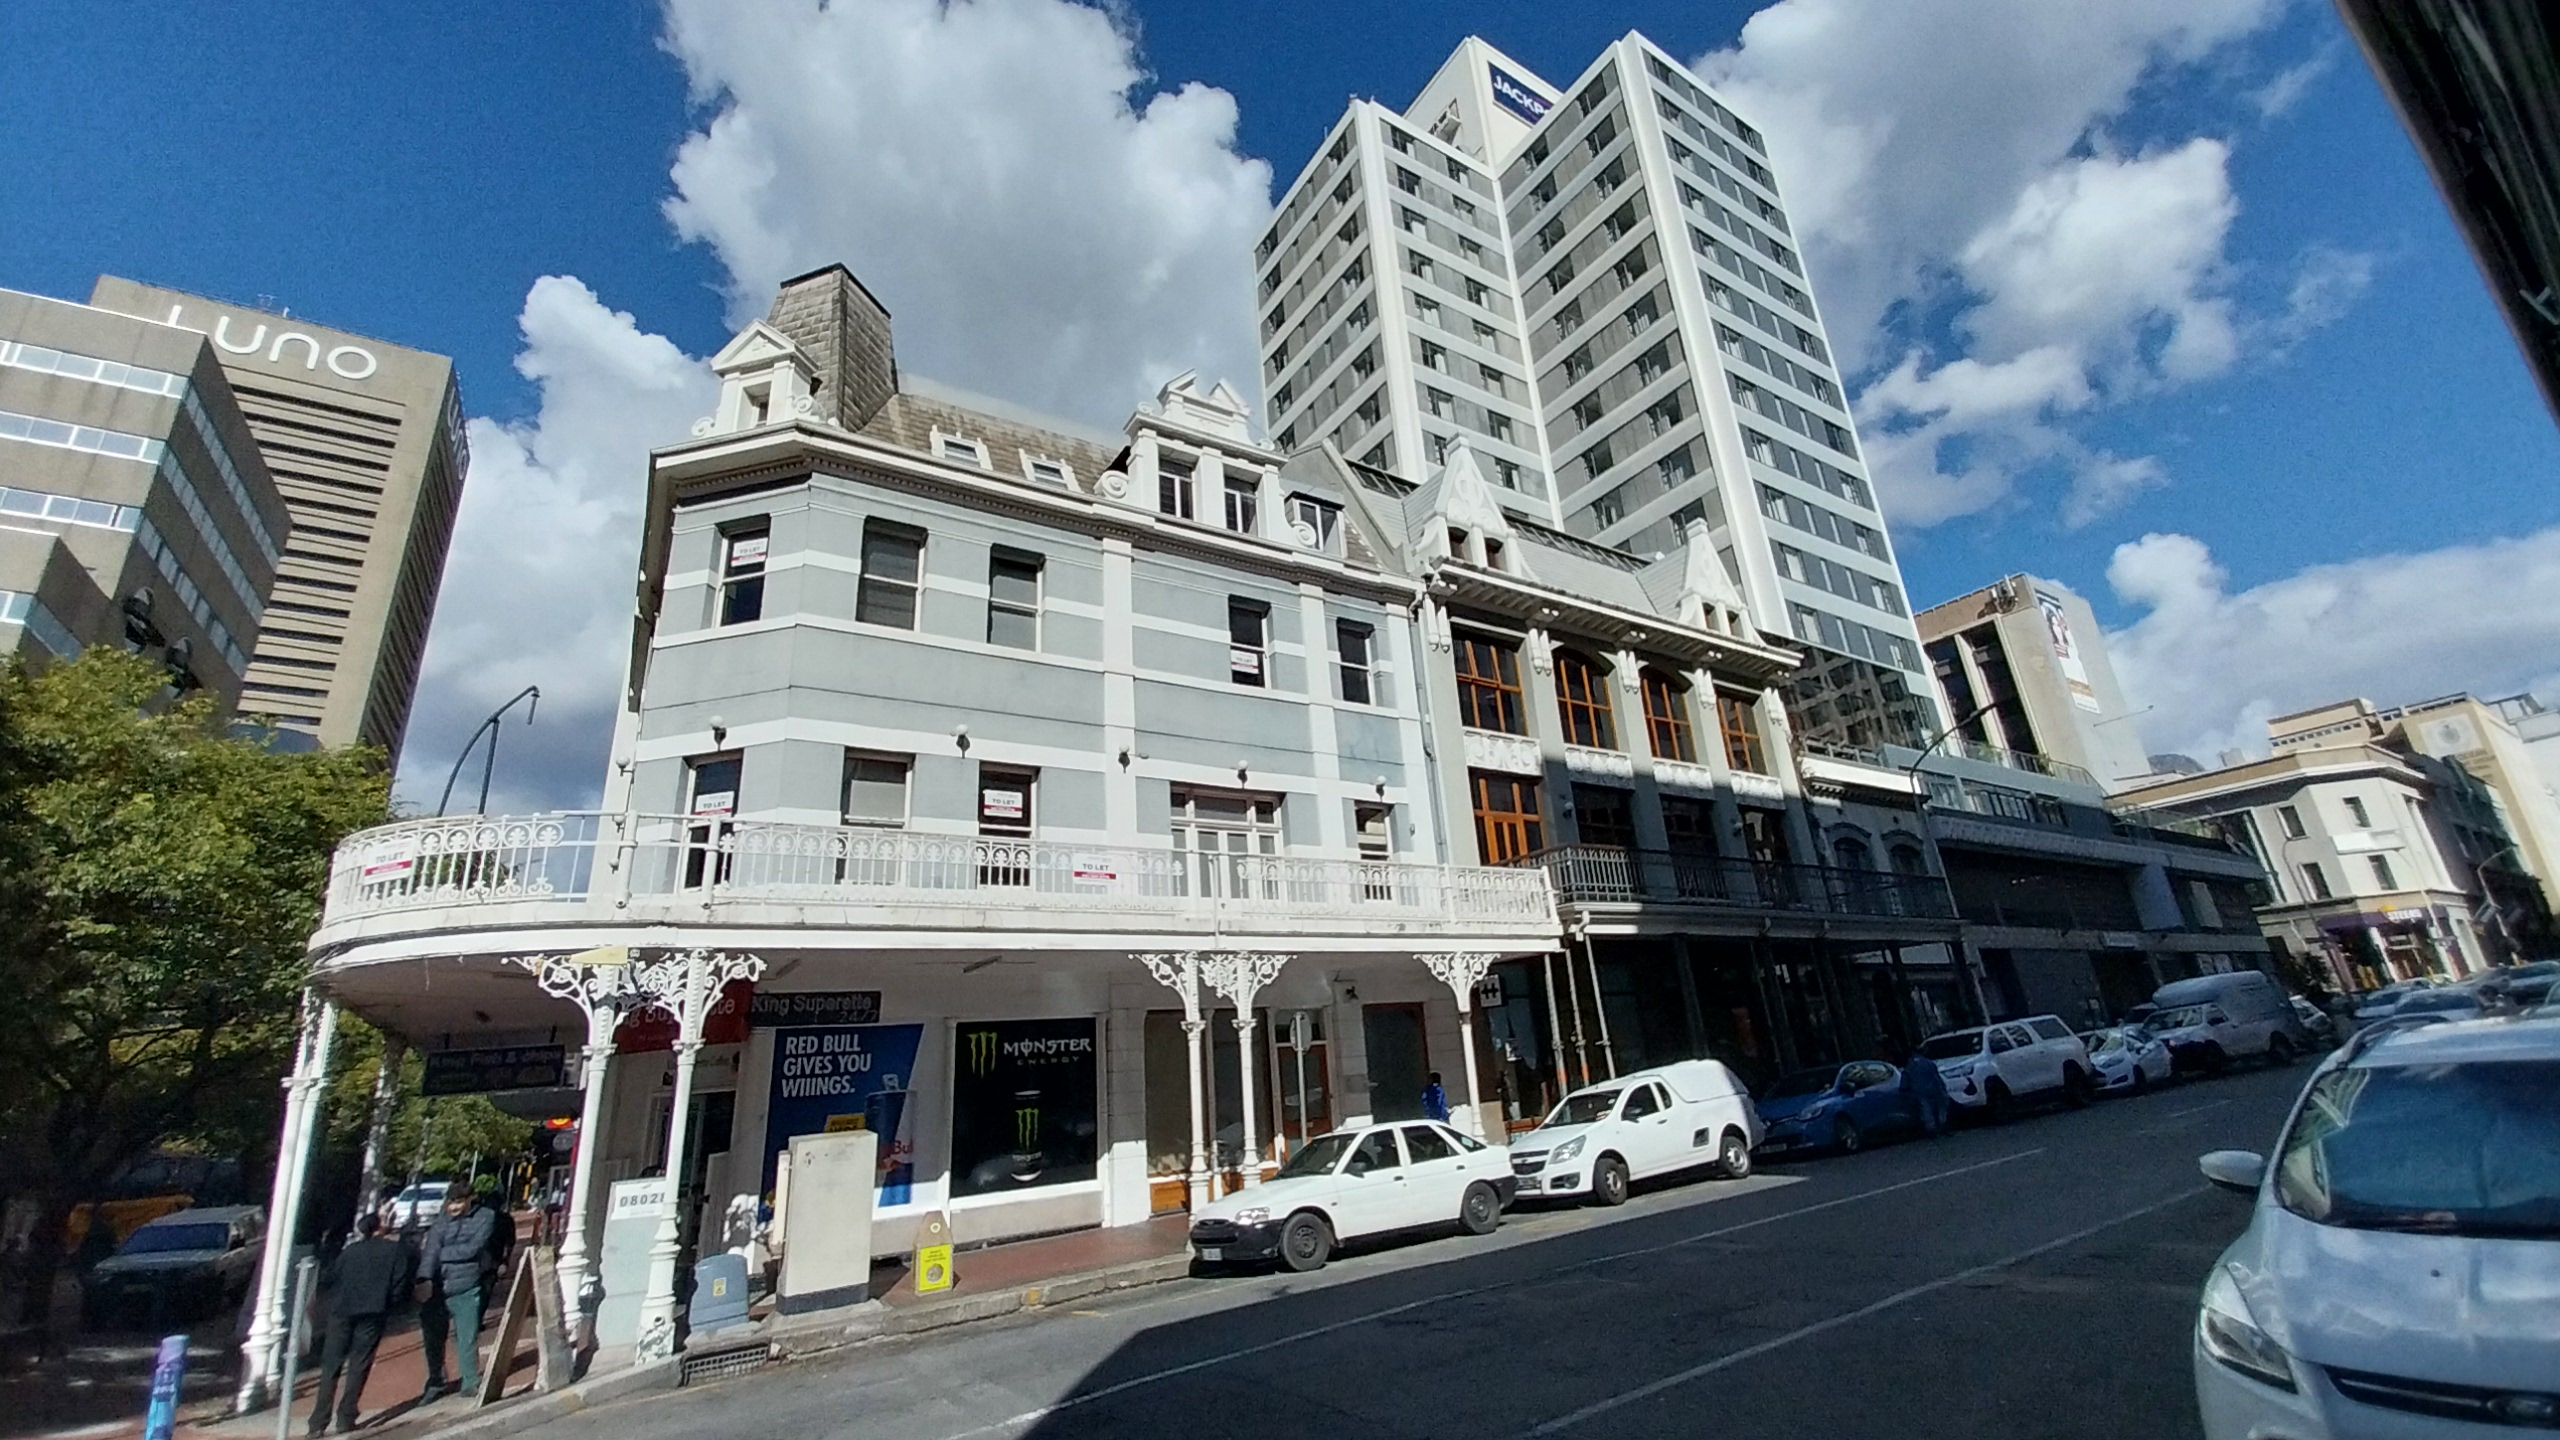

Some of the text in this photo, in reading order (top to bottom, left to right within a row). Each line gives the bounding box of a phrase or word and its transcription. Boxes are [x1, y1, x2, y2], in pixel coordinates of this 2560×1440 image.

[376, 851, 406, 864] TO LET
[785, 1033, 862, 1055] RED BULL
[1003, 1038, 1092, 1057] MONSTER
[783, 1053, 872, 1077] GIVES YOU
[782, 1074, 856, 1098] WIIINGS.
